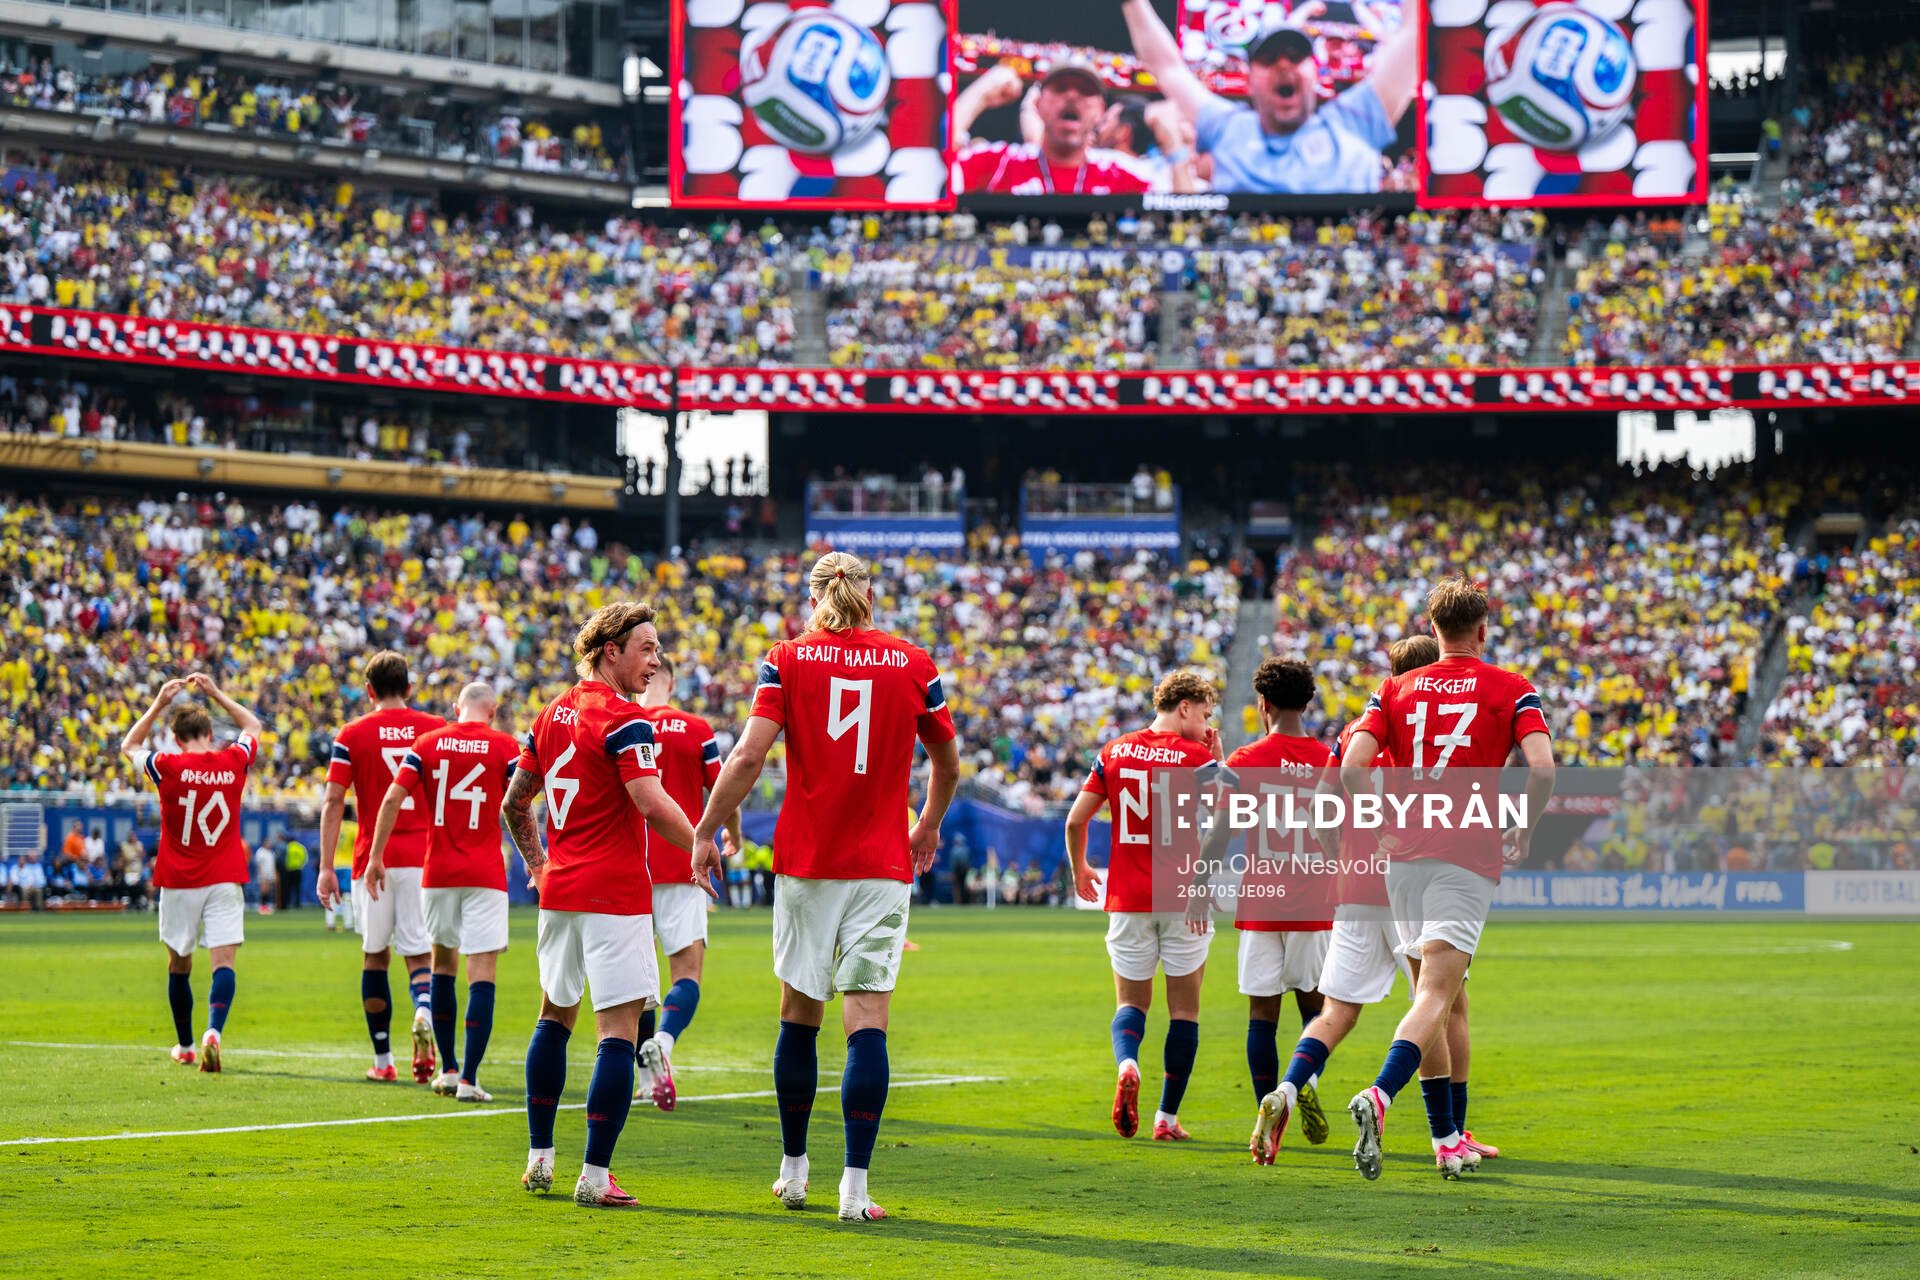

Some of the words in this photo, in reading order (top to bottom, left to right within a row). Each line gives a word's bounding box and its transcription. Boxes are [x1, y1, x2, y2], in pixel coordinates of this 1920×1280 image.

[797, 645, 840, 664] BRAUT
[844, 648, 909, 668] HAALAND
[1414, 677, 1477, 694] HEGGEM
[379, 726, 415, 740] BERGE
[827, 676, 873, 775] 9
[436, 737, 489, 754] AURSNES
[1110, 742, 1187, 765] SCHJELDERUP
[1406, 702, 1478, 781] 17
[180, 768, 236, 785] ØDEGAARD
[1280, 758, 1314, 779] BOBB
[432, 759, 488, 830] 14
[544, 741, 580, 830] 6
[178, 789, 231, 847] 10
[1119, 767, 1172, 847] 21
[1551, 876, 1619, 906] UNITES
[1621, 872, 1658, 908] the
[1660, 872, 1727, 911] World
[1735, 880, 1783, 903] FIFA
